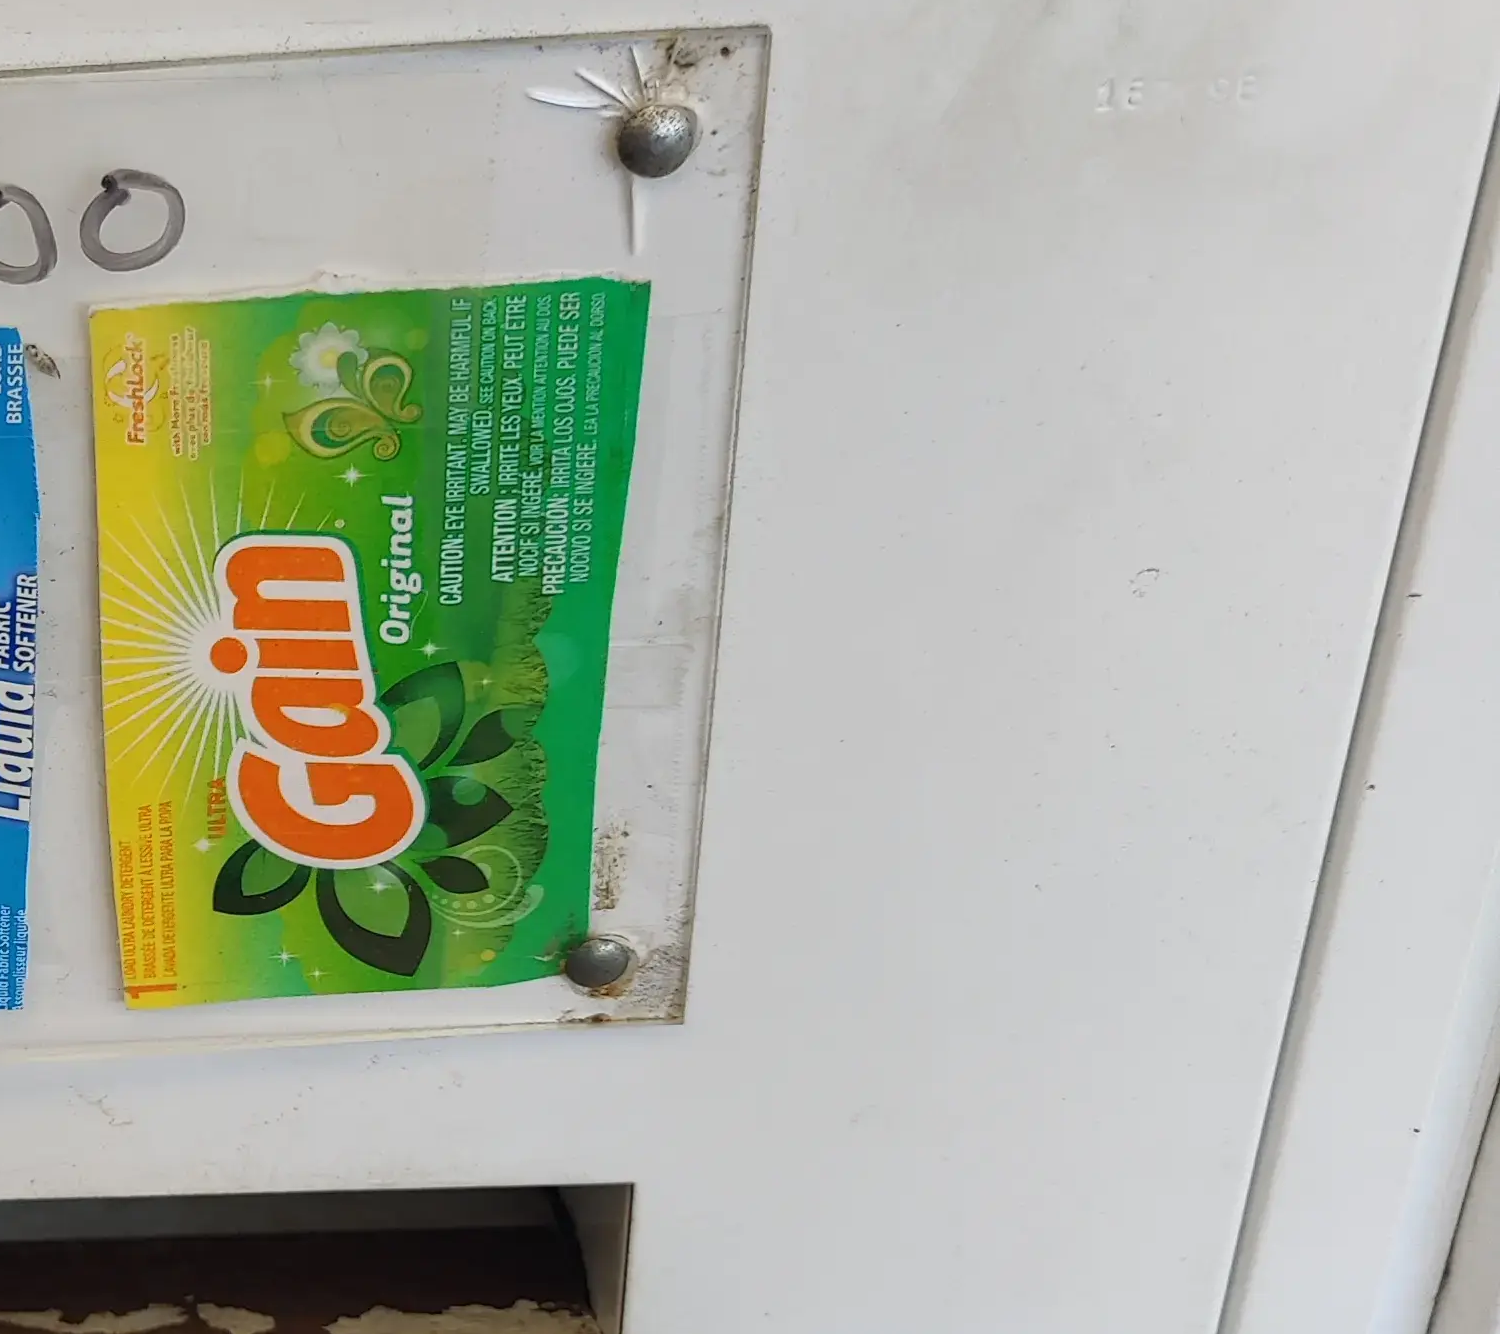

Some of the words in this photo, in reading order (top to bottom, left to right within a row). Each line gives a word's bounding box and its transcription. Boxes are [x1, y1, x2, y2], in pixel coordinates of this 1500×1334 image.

[451, 298, 472, 311] IF
[482, 297, 498, 325] BACK.
[501, 295, 527, 330] ÊTRE
[560, 292, 581, 320] SER
[481, 327, 495, 341] ON
[536, 319, 550, 332] AU
[589, 329, 604, 341] AL
[449, 315, 472, 380] HARMFUL
[480, 343, 496, 384] CAUTION
[503, 334, 525, 369] PEUT
[533, 334, 550, 384] ATTENTION
[556, 324, 579, 369] PUEDE
[125, 339, 145, 444] FreshLock
[449, 384, 469, 403] BE
[480, 386, 494, 404] SEE
[501, 373, 523, 412] YEUX.
[530, 386, 547, 428] MENTION
[554, 374, 576, 413] OJOS.
[448, 406, 468, 435] MAY
[583, 418, 598, 435] LEA
[585, 403, 599, 416] LA
[500, 415, 521, 441] LES
[530, 430, 544, 442] LA
[553, 417, 573, 443] LOS
[469, 406, 494, 495] SWALLOWED.
[498, 444, 520, 486] IRRITE
[528, 443, 543, 466] VOIR
[551, 446, 572, 488] IRRITA
[574, 439, 597, 495] INGIERE.
[445, 438, 468, 502] IRRITANT.
[518, 467, 543, 519] INGÉRÉ.
[574, 498, 593, 516] SE
[444, 505, 465, 530] EYE
[520, 522, 540, 535] SI
[572, 519, 592, 532] SI
[491, 498, 517, 583] ATTENTION
[518, 538, 539, 576] NOCIF
[541, 493, 569, 595] PRECAUCIÓN:
[379, 494, 422, 645] Original
[439, 534, 465, 605] CAUTION:
[569, 535, 591, 583] NOCIVO
[13, 574, 38, 674] SOFTENER
[209, 546, 413, 860] Gain
[137, 804, 152, 832] ULTRA
[206, 776, 226, 839] ULTRA
[158, 825, 172, 837] LA
[118, 841, 134, 889] DETERGENT
[159, 839, 174, 862] PARA
[160, 864, 175, 890] ULTRA
[125, 983, 178, 1000] 1
